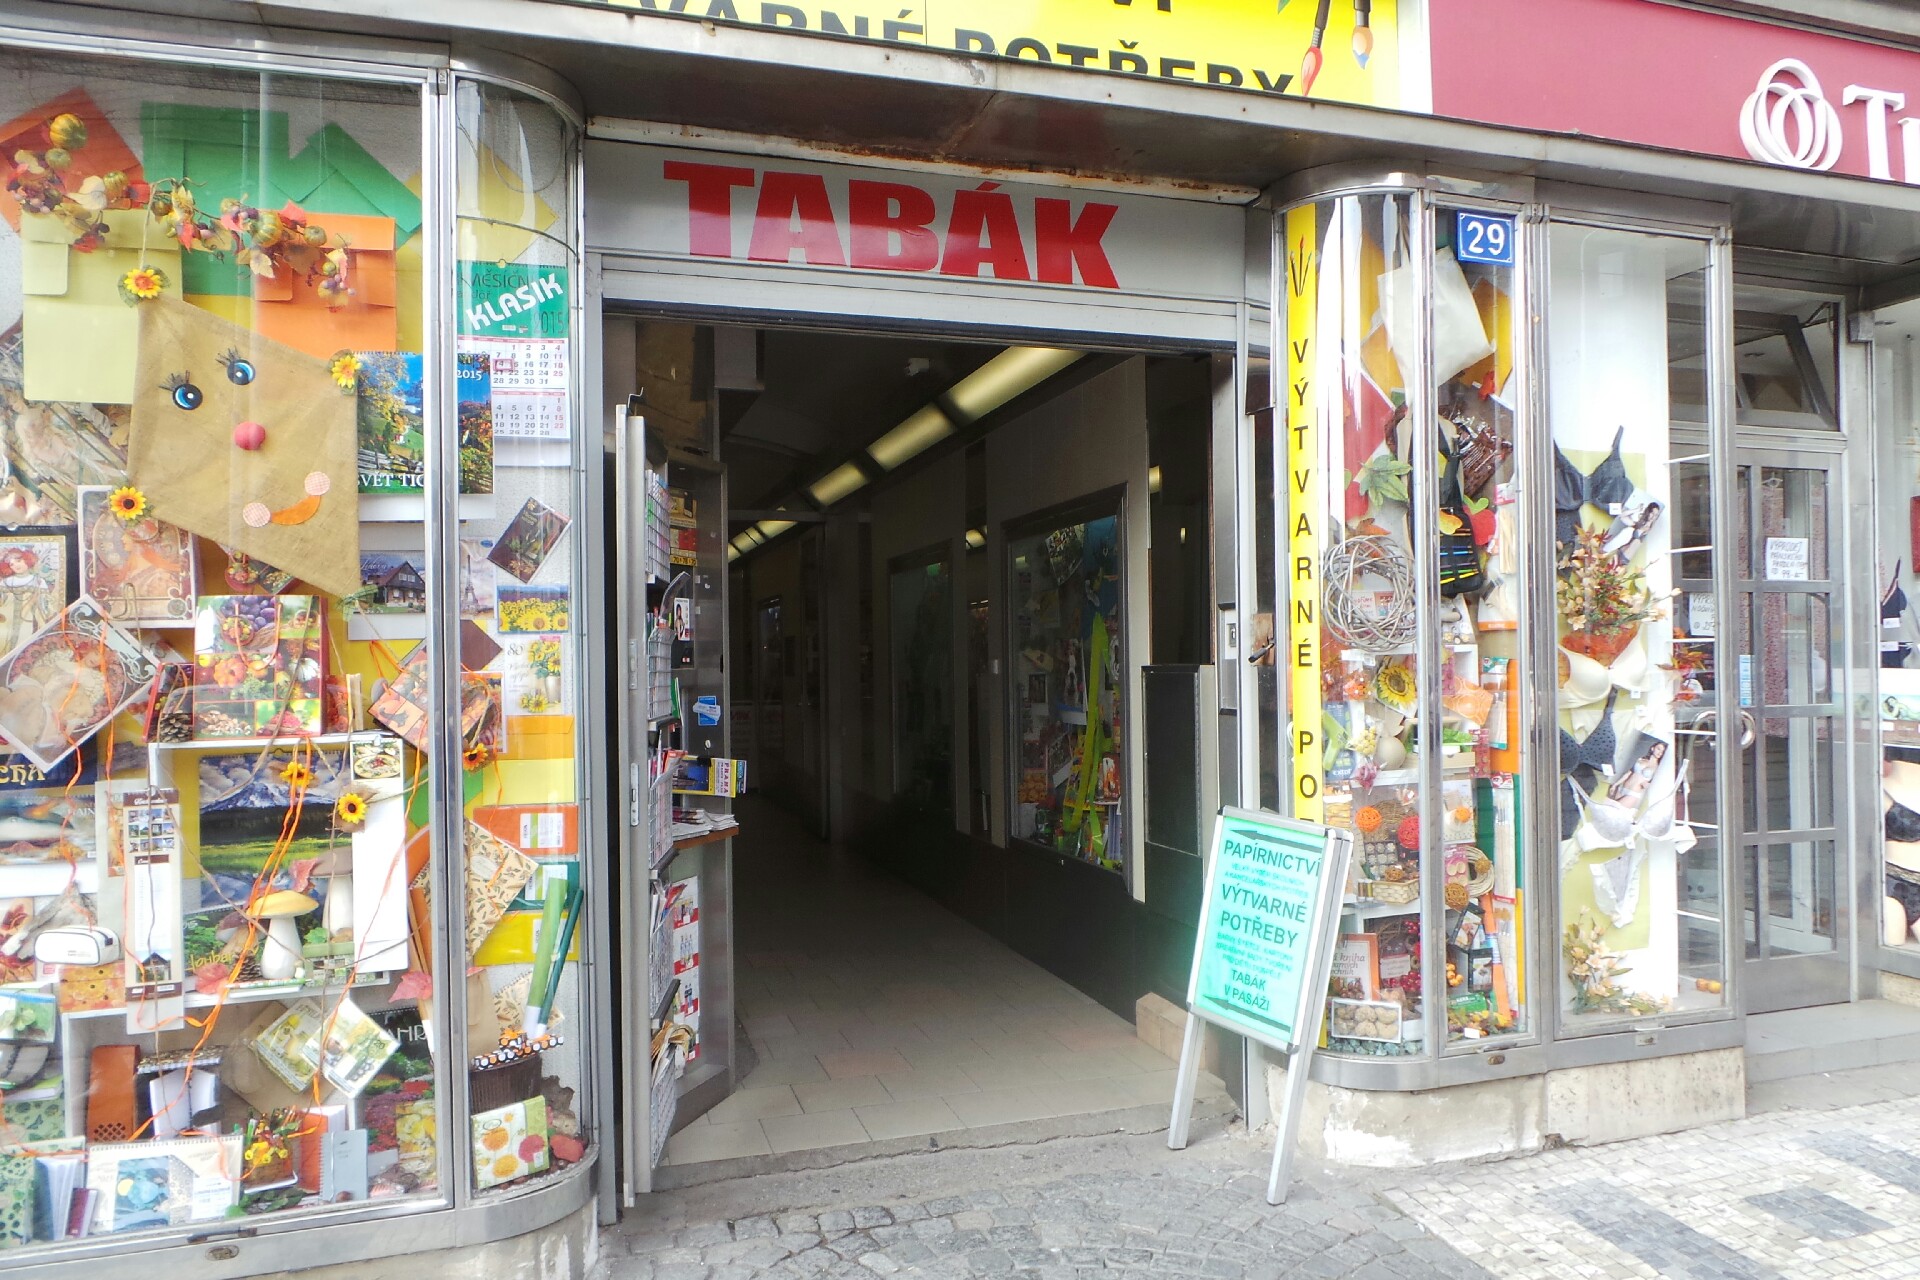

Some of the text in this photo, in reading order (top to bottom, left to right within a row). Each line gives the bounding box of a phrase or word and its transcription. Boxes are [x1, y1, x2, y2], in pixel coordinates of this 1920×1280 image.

[663, 161, 1119, 289] TABÁK
[1467, 221, 1505, 255] 29
[466, 273, 563, 331] KLASIK
[457, 370, 482, 380] 2015
[1293, 338, 1317, 821] VÝTVARNÉ PO
[1224, 840, 1321, 877] PAPÍRNICTVÍ
[1222, 883, 1308, 922] VÝTVARNÉ
[1220, 910, 1298, 948] POTŘEBY
[1225, 984, 1270, 1011] V PASÁŽI
[1231, 969, 1266, 991] TABÁK
